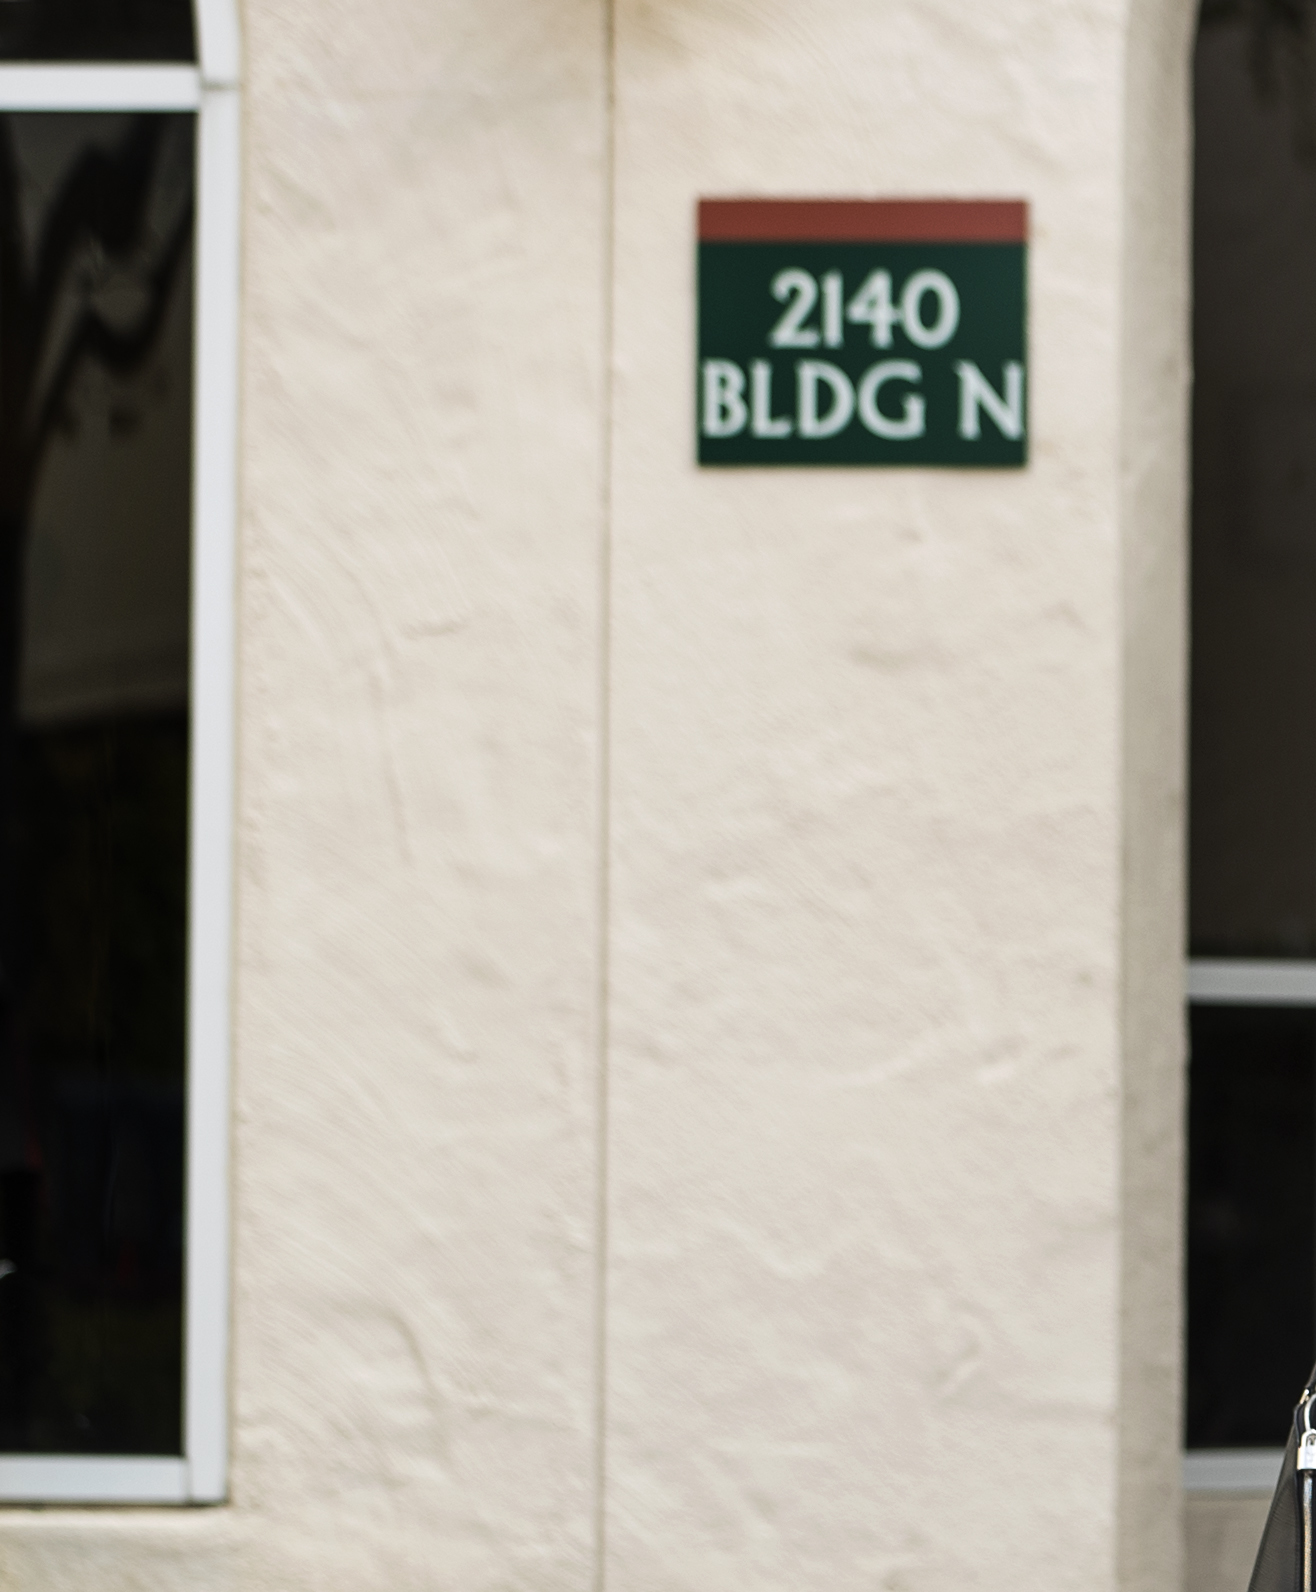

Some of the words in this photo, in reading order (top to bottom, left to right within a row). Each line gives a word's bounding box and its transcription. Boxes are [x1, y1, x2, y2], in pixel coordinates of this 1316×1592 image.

[768, 266, 961, 350] 2140
[700, 358, 926, 440] BLDG
[954, 358, 1024, 441] N
